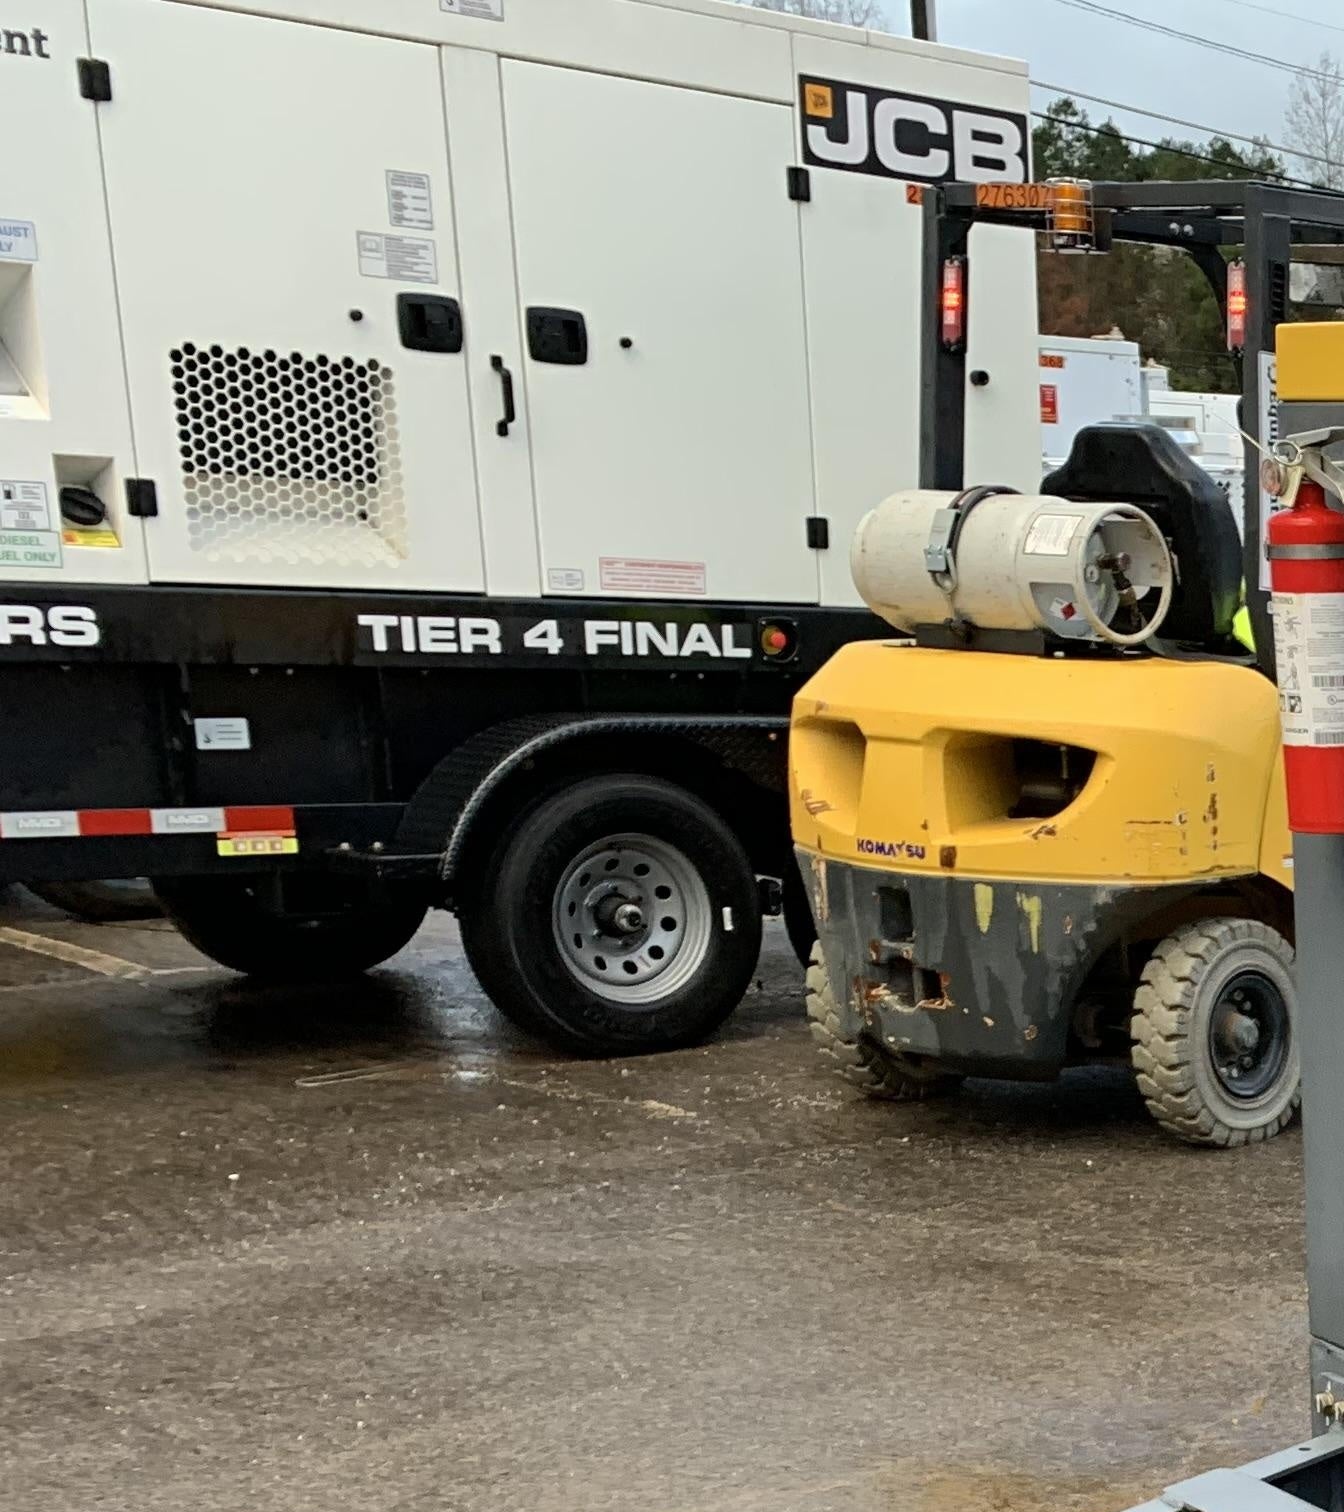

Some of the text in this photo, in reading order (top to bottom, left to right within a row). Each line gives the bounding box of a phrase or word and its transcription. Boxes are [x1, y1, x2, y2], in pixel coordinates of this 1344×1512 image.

[0, 26, 51, 59] nt
[806, 90, 1026, 183] JCB
[978, 183, 1051, 209] 276307
[0, 604, 101, 647] RS
[356, 613, 753, 659] TIER 4 FINAL
